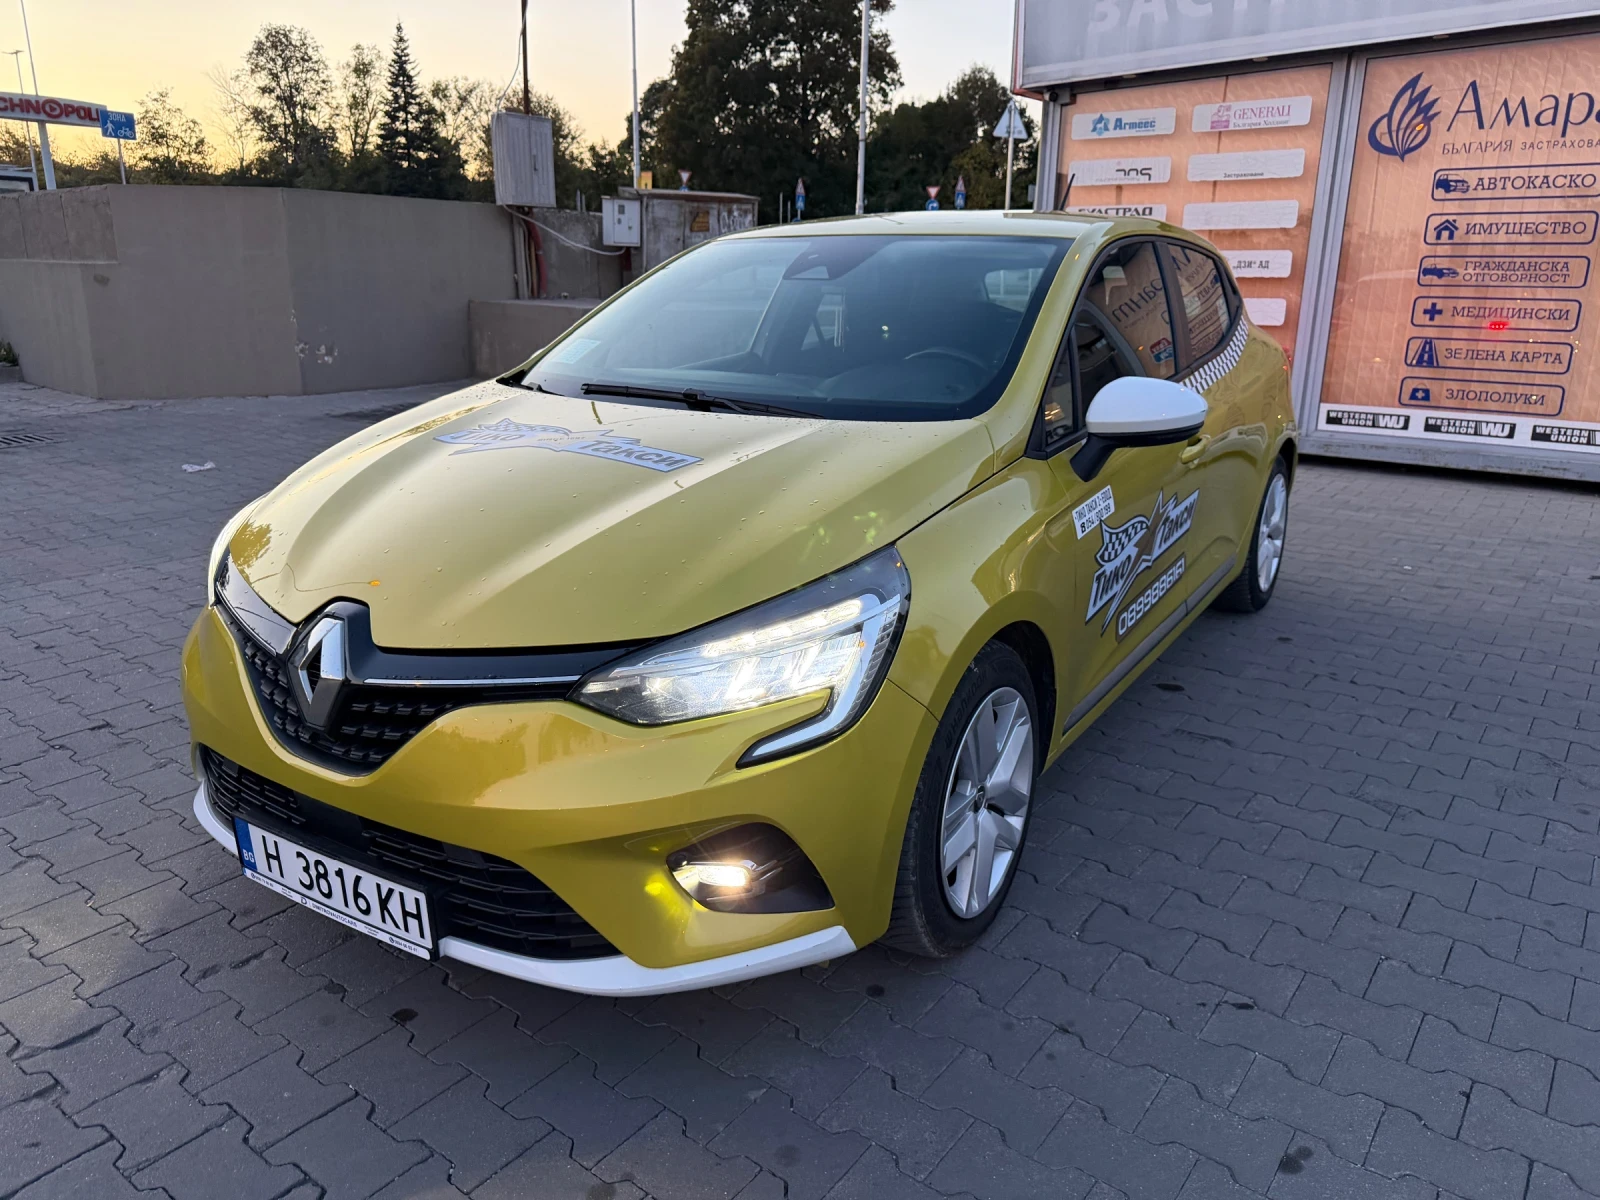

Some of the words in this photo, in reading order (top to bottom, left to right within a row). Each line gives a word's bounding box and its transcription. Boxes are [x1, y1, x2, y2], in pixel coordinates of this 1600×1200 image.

[1233, 104, 1292, 120] GENERALI
[1446, 79, 1600, 138] Амар
[108, 112, 126, 122] ЗОНА
[1442, 139, 1513, 155] БЪЛГАРИЯ
[1472, 173, 1597, 191] АВТОКАСКО
[1465, 221, 1587, 237] ИМУЩЕСТВО
[1257, 260, 1270, 269] АД
[1464, 261, 1570, 272] ГРАЖДАНСКА
[1462, 272, 1571, 283] ОТГОВОРНОСТ
[1451, 306, 1571, 321] МЕДИЦИНСКИ
[1444, 348, 1506, 362] ЗЕЛЕНА
[1510, 351, 1563, 365] КАРТА
[1445, 388, 1546, 406] ЗЛОПОЛУКИ
[1329, 411, 1374, 420] WESTERN
[1341, 418, 1373, 427] UNION
[1379, 415, 1405, 429] WU
[1428, 418, 1476, 428] WESTERN
[1441, 426, 1475, 434] UNION
[1481, 422, 1510, 437] WU
[1535, 426, 1589, 437] WESTERN
[1550, 434, 1588, 444] UNION
[579, 440, 688, 467] Такси
[244, 849, 255, 863] BG
[262, 834, 284, 879] H
